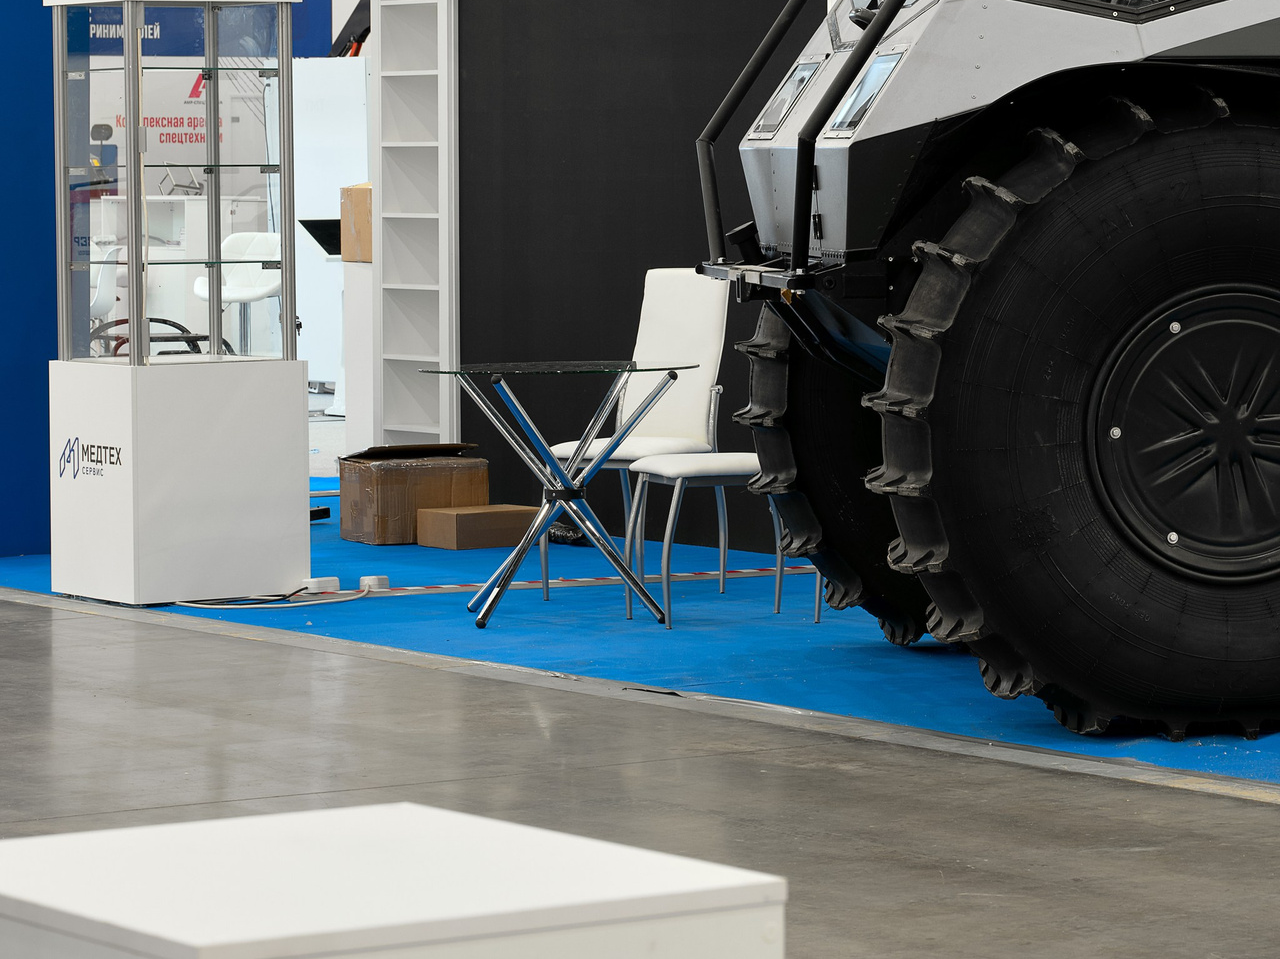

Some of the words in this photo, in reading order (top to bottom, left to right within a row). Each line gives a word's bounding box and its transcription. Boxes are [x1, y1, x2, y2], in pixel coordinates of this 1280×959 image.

[116, 114, 185, 128] Колексная
[187, 116, 223, 130] ареа
[159, 132, 223, 145] спецтехни
[82, 443, 122, 466] МЕДТЕХ
[82, 466, 104, 477] СЕРВИС
